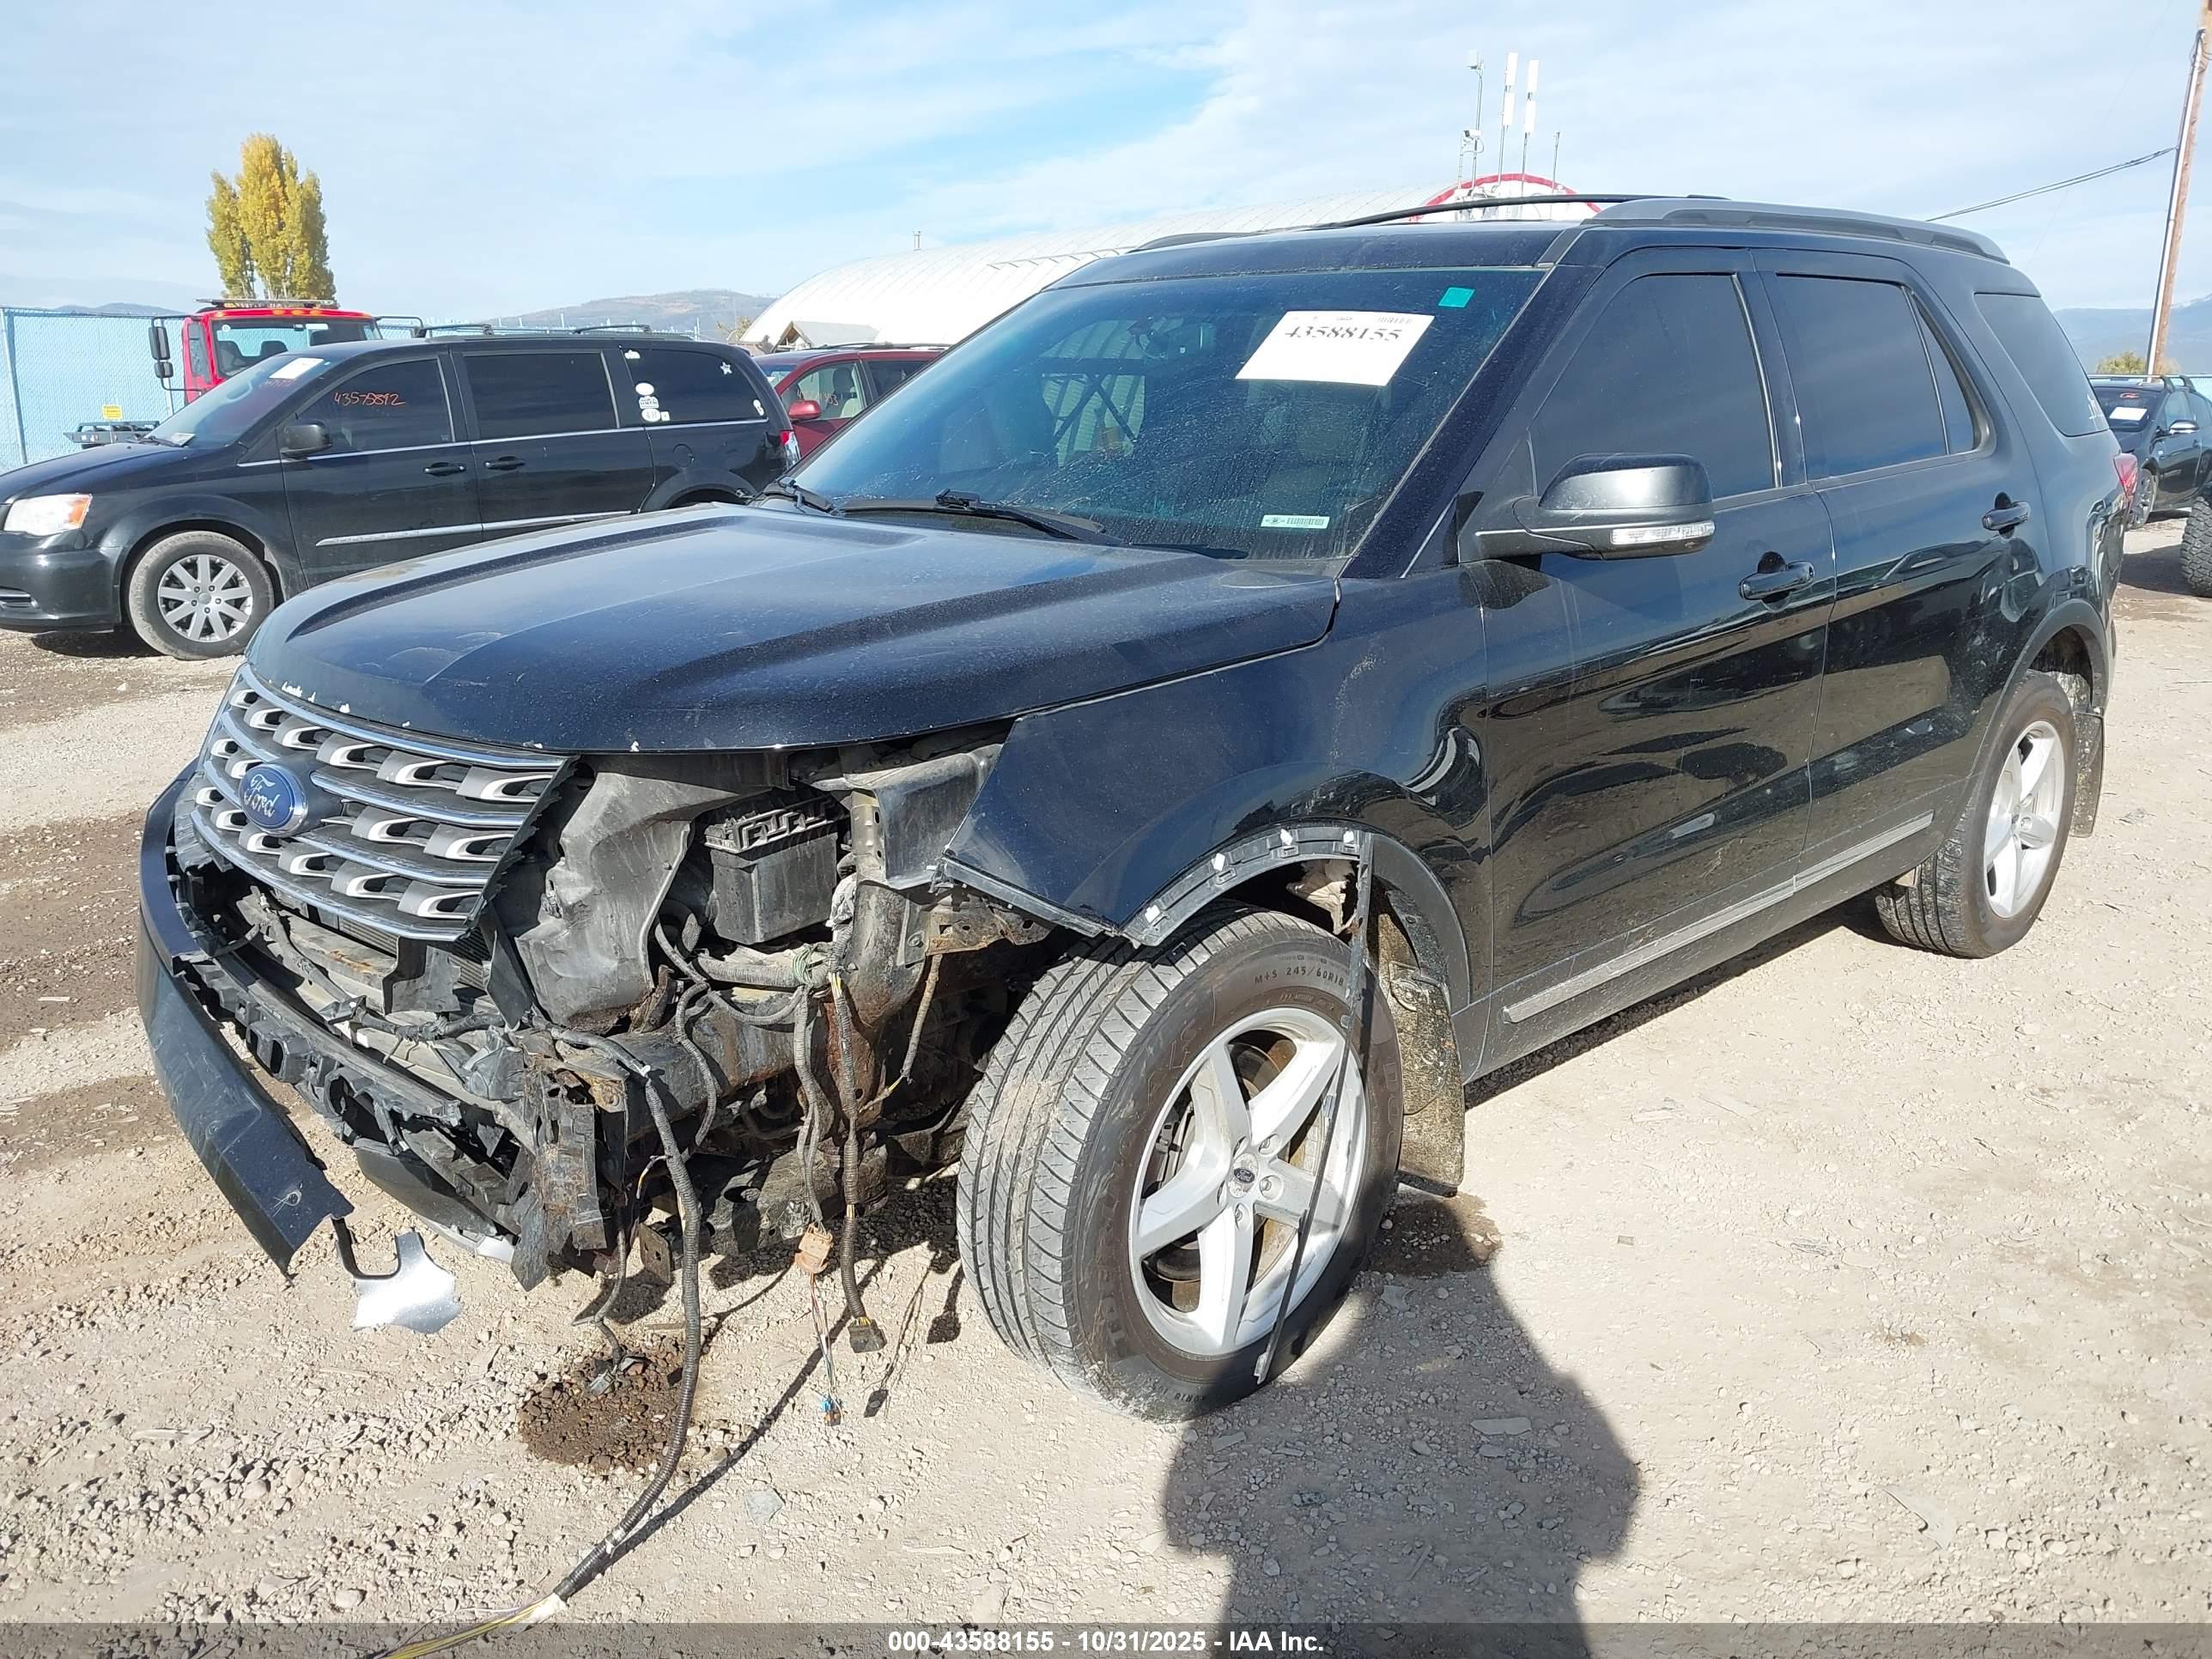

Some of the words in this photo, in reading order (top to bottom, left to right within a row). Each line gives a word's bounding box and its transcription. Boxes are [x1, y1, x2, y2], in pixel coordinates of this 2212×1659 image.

[1285, 325, 1402, 341] 43588155
[244, 774, 281, 818] Ford
[1255, 969, 1279, 985] M+S
[1285, 966, 1345, 987] 245/60R18
